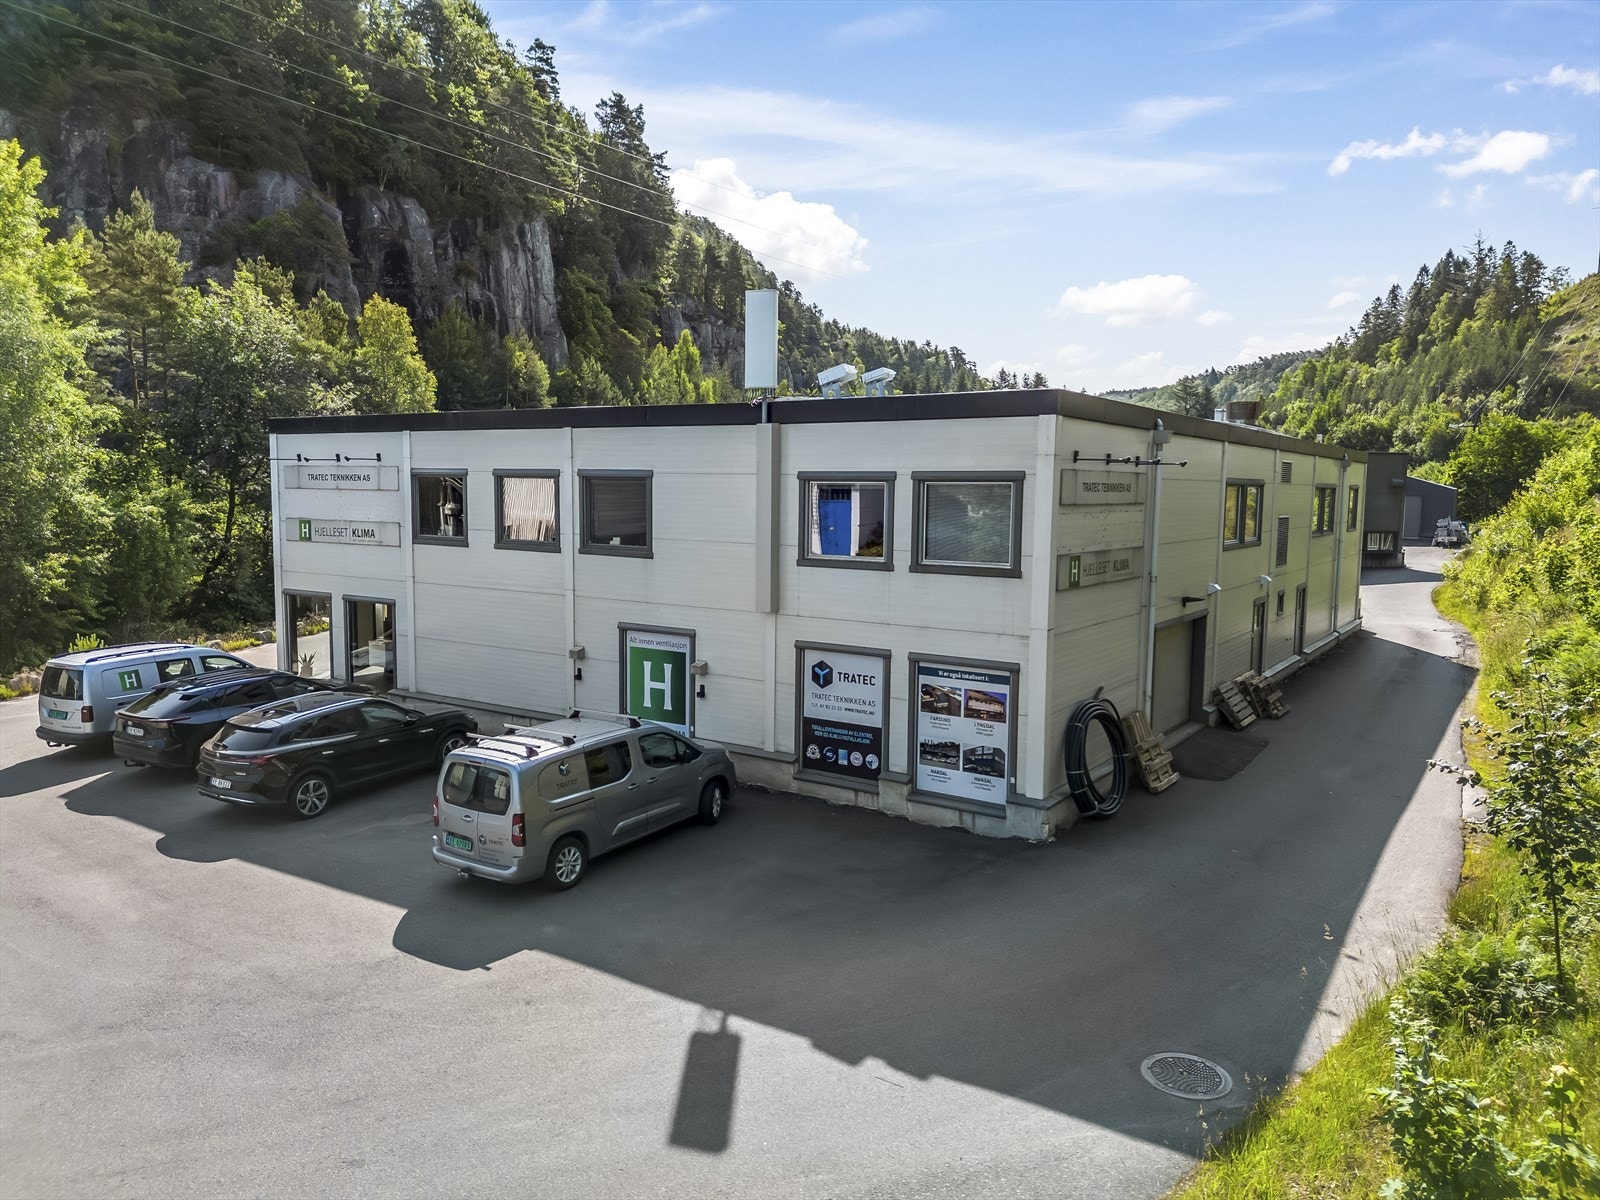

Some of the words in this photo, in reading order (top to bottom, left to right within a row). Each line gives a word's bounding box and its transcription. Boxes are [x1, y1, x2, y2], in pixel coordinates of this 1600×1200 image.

[307, 473, 329, 482] TRATEC
[329, 473, 362, 482] TEKNIKKEN
[362, 474, 371, 482] AS
[1082, 482, 1100, 493] TRATEC
[1101, 482, 1125, 493] TEKNIKKEN
[1125, 483, 1132, 493] AS
[301, 523, 309, 538] H
[314, 526, 349, 538] HJELLESET
[352, 527, 376, 539] KLIMA
[1071, 561, 1079, 582] H
[1083, 560, 1111, 577] HJELLESET
[1112, 558, 1130, 572] KLIMA
[629, 636, 638, 644] Alt
[638, 637, 655, 646] innen
[655, 639, 688, 650] ventilasjon
[124, 673, 138, 688] H
[837, 671, 876, 687] TRATEC
[949, 671, 962, 679] også
[962, 673, 985, 681] lokalisert
[643, 661, 672, 710] H
[811, 692, 832, 702] TRATEC
[832, 695, 867, 706] TEKNIKKEN
[867, 700, 876, 708] AS
[843, 707, 876, 716] WWW.TRATEC.NO
[929, 715, 952, 723] FARSUND
[973, 721, 996, 730] LYNGDAL
[930, 768, 949, 777] MANDAL
[556, 778, 579, 790] TRATEC
[973, 776, 993, 785] MANDAL
